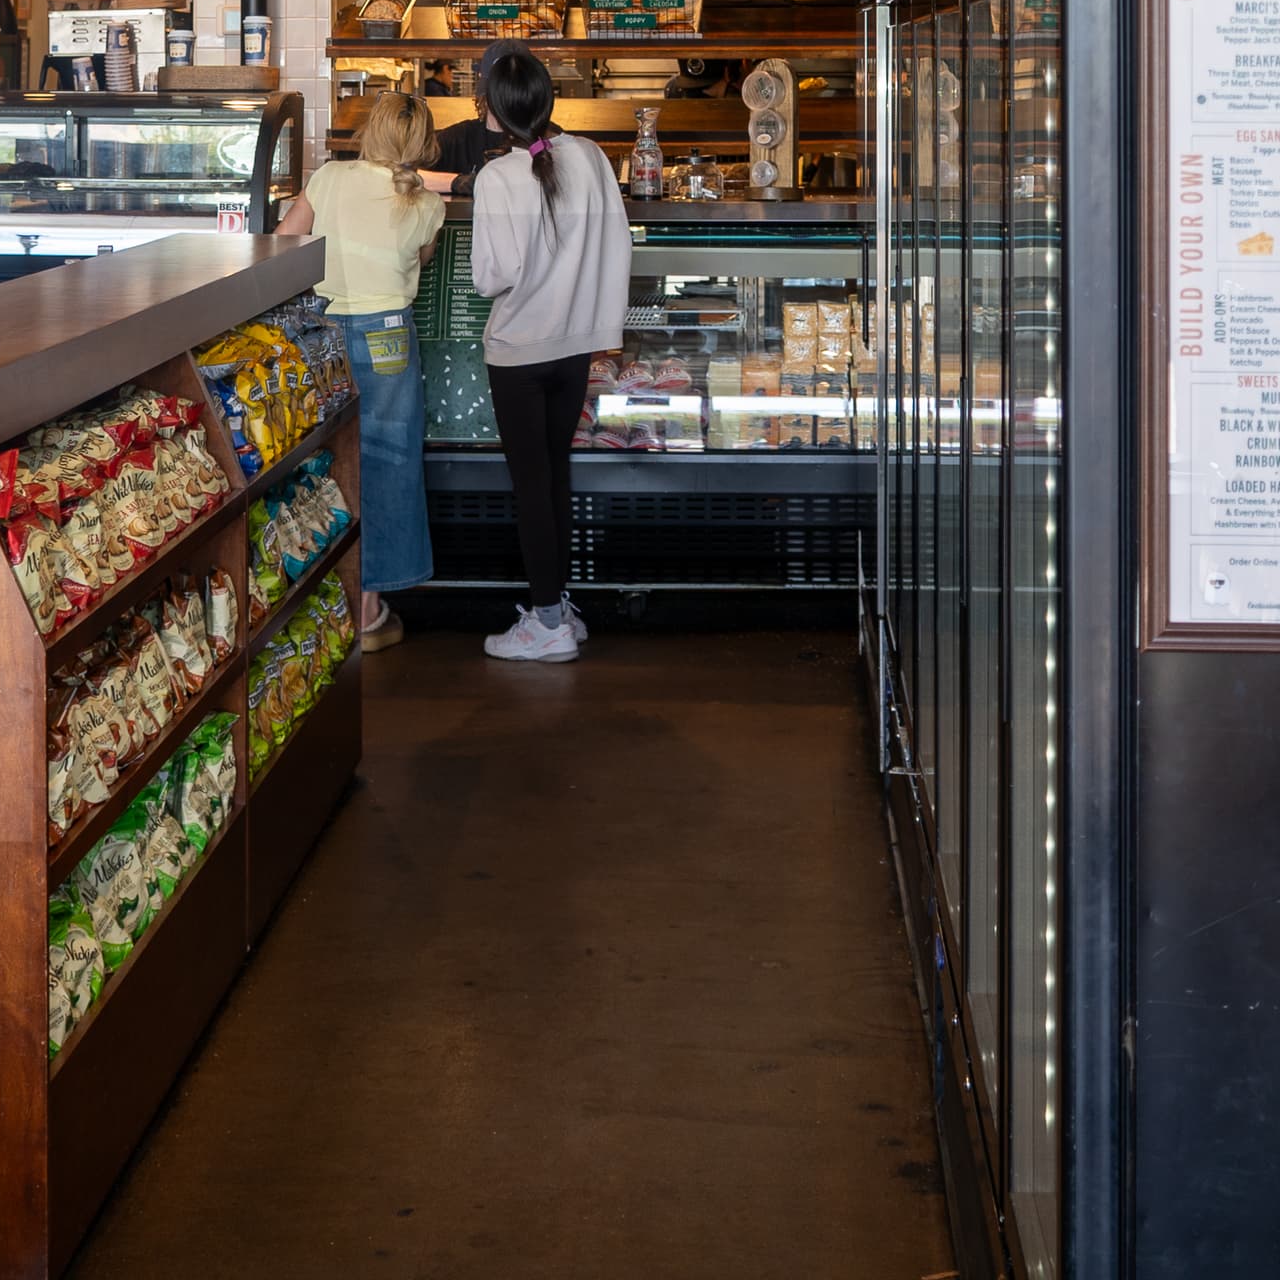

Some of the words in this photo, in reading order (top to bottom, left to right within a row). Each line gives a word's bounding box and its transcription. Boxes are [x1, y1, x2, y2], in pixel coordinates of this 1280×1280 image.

[489, 8, 507, 16] ONION
[1236, 131, 1256, 142] EGG
[1180, 154, 1203, 204] OWN
[1180, 216, 1203, 276] YOUR
[1180, 288, 1203, 356] BUILD
[1238, 376, 1278, 388] SWEETS
